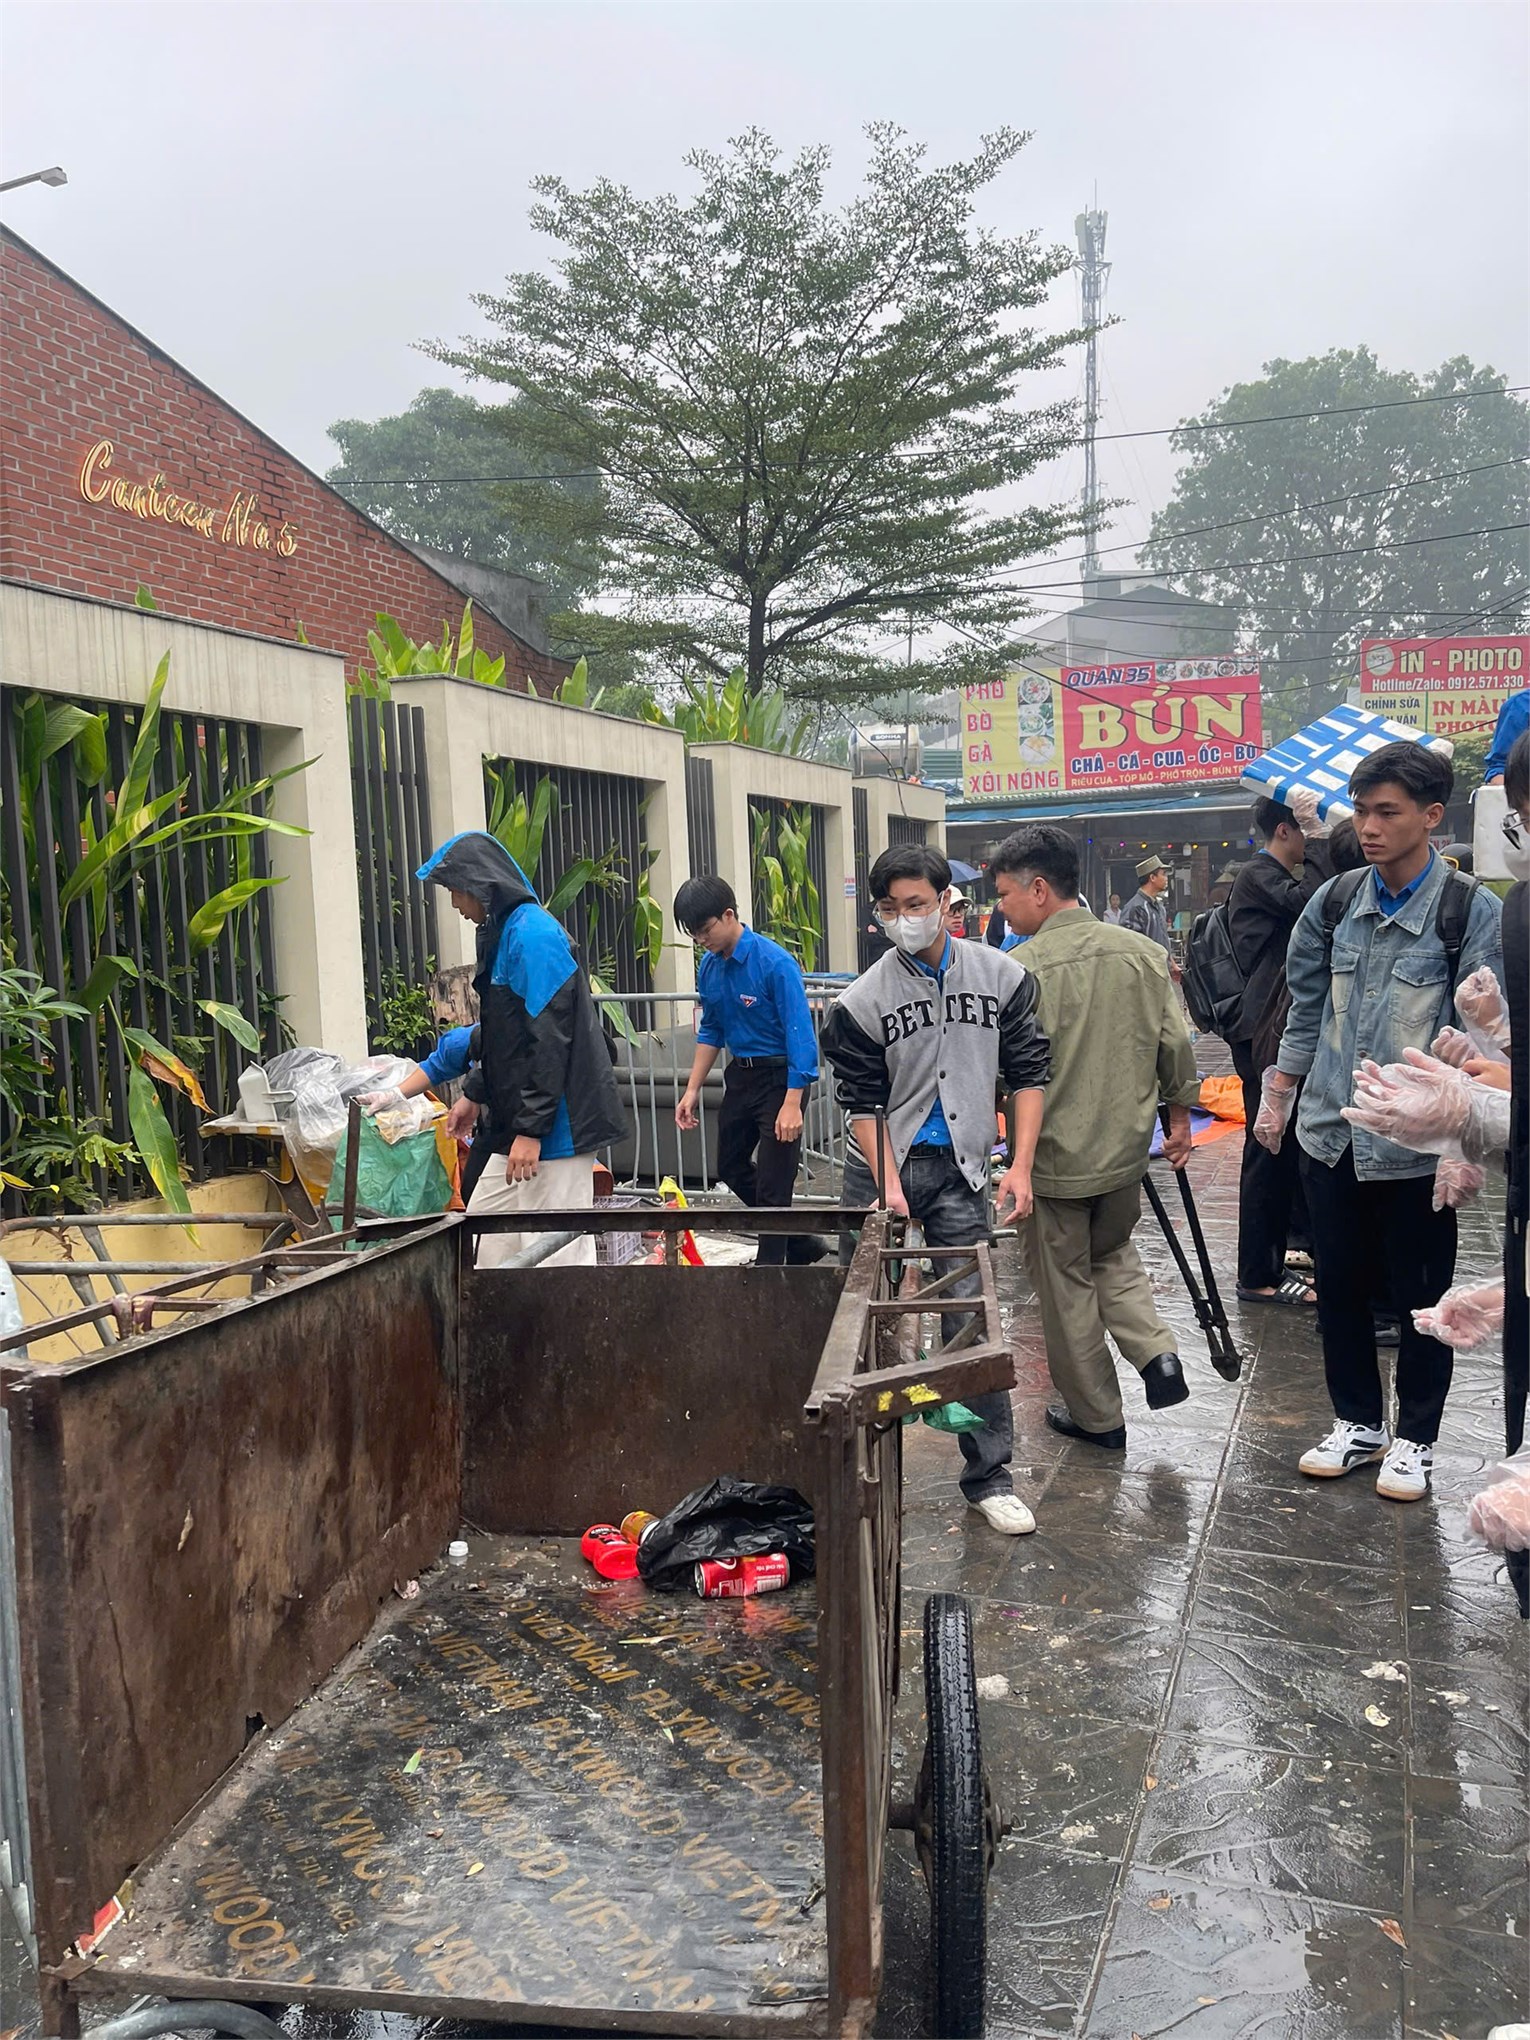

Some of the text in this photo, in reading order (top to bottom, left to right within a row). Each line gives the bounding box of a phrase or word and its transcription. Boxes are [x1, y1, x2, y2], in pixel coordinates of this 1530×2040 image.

[79, 440, 216, 538] Canteen
[1400, 650, 1425, 674] IN
[1448, 648, 1523, 672] PHOTO
[1125, 666, 1152, 683] 35
[1372, 675, 1524, 691] Hotline/Zalo: 0912.571.330
[967, 708, 992, 732] BÒ
[1077, 684, 1248, 749] BÚN
[1433, 700, 1454, 716] IN
[968, 740, 993, 762] GÀ
[1071, 752, 1105, 775] CHẢ
[1118, 751, 1140, 771] CÁ
[1153, 749, 1186, 768] CUA
[1198, 742, 1221, 764] ỐC
[968, 768, 1059, 793] XÔI NÓNG
[1094, 776, 1113, 785] CUA
[1180, 767, 1206, 779] TRỘN
[1212, 764, 1232, 775] BÚN
[881, 993, 1000, 1049] BETTER
[521, 1611, 639, 1684] VIETNAM
[430, 1631, 544, 1709] VIETNAM
